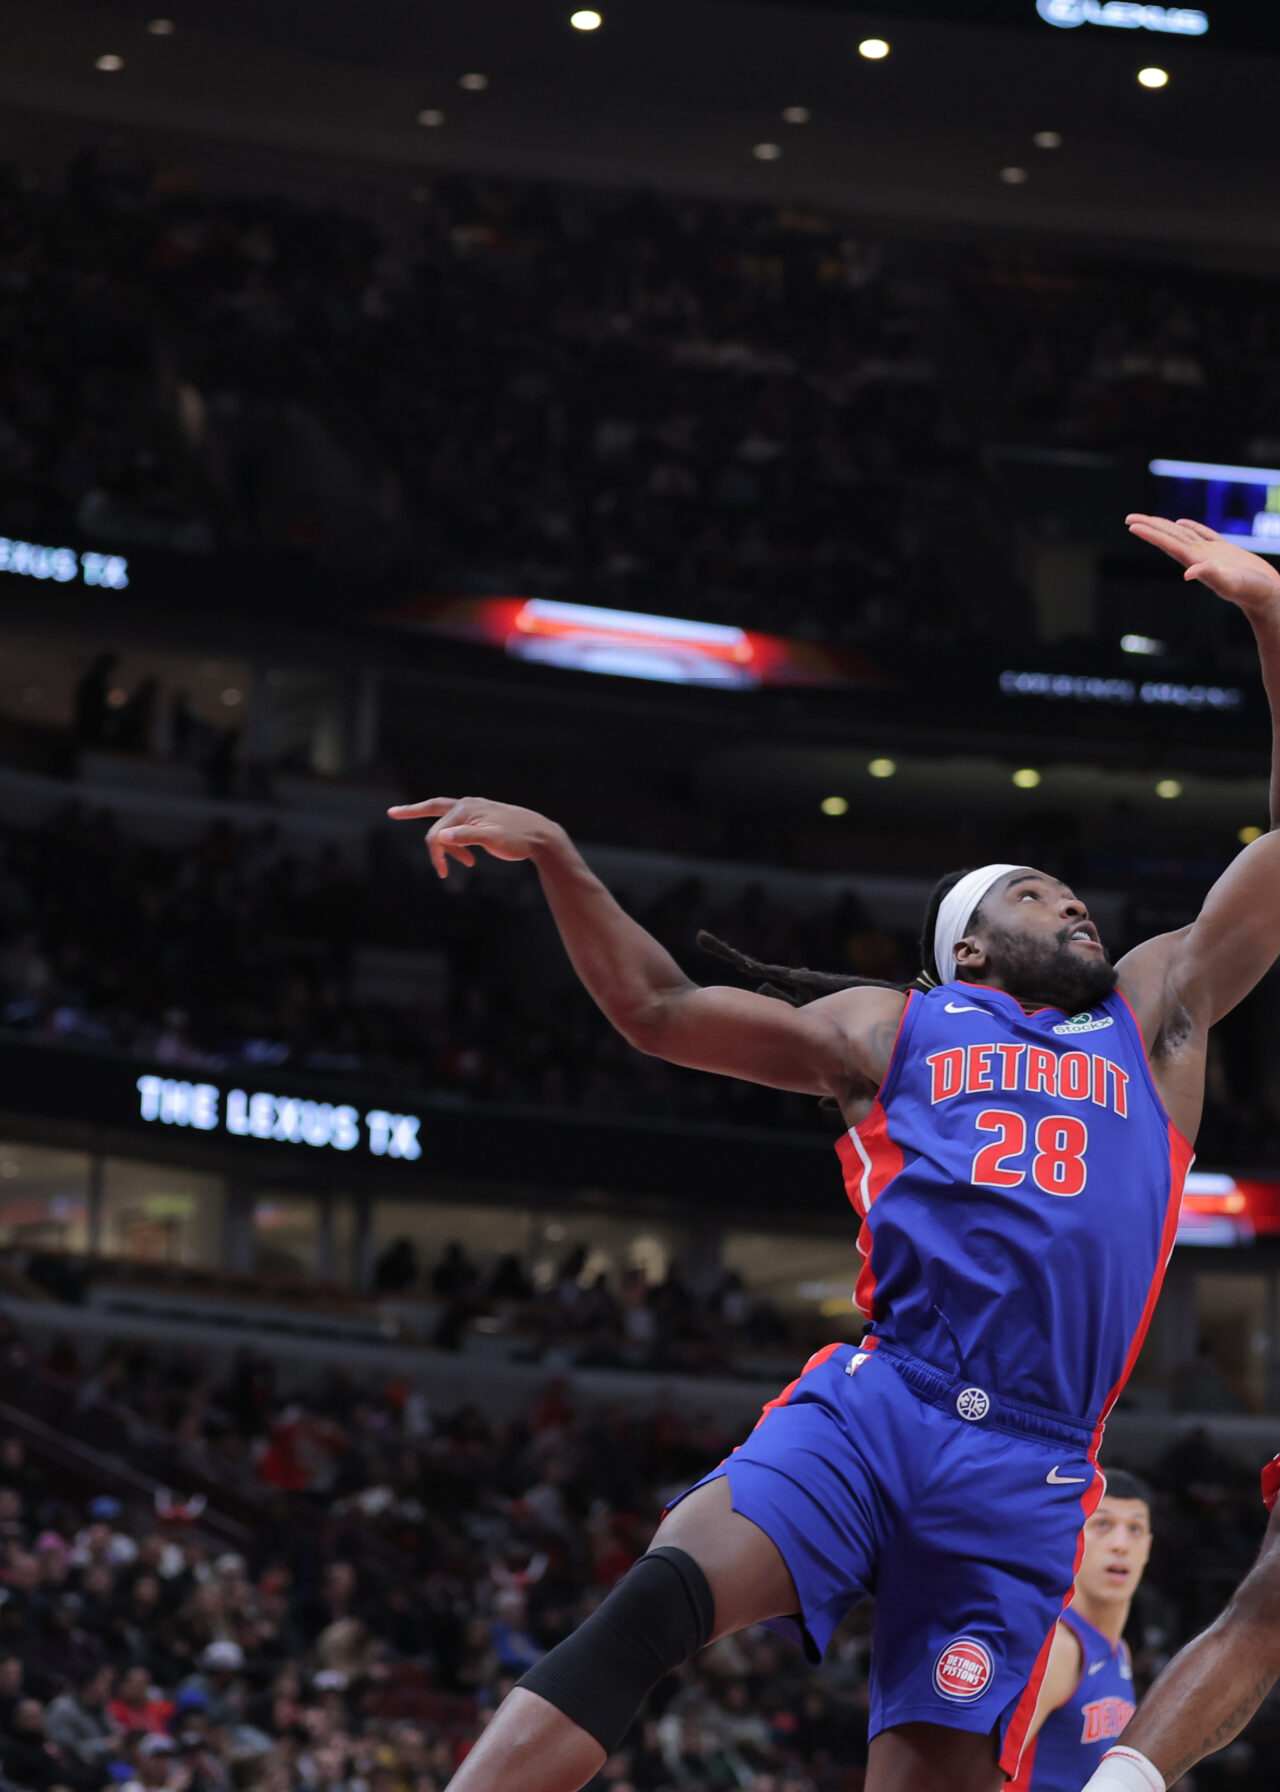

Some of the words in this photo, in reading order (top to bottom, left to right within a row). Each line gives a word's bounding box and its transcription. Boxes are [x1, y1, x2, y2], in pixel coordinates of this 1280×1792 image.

[80, 551, 129, 590] TX
[925, 1043, 1130, 1119] DETROIT
[136, 1075, 220, 1131] THE
[225, 1089, 360, 1151] LEXUS
[365, 1110, 422, 1161] TX
[971, 1108, 1088, 1197] 28
[942, 1664, 981, 1686] PISTONS
[946, 1654, 985, 1676] DETROIT
